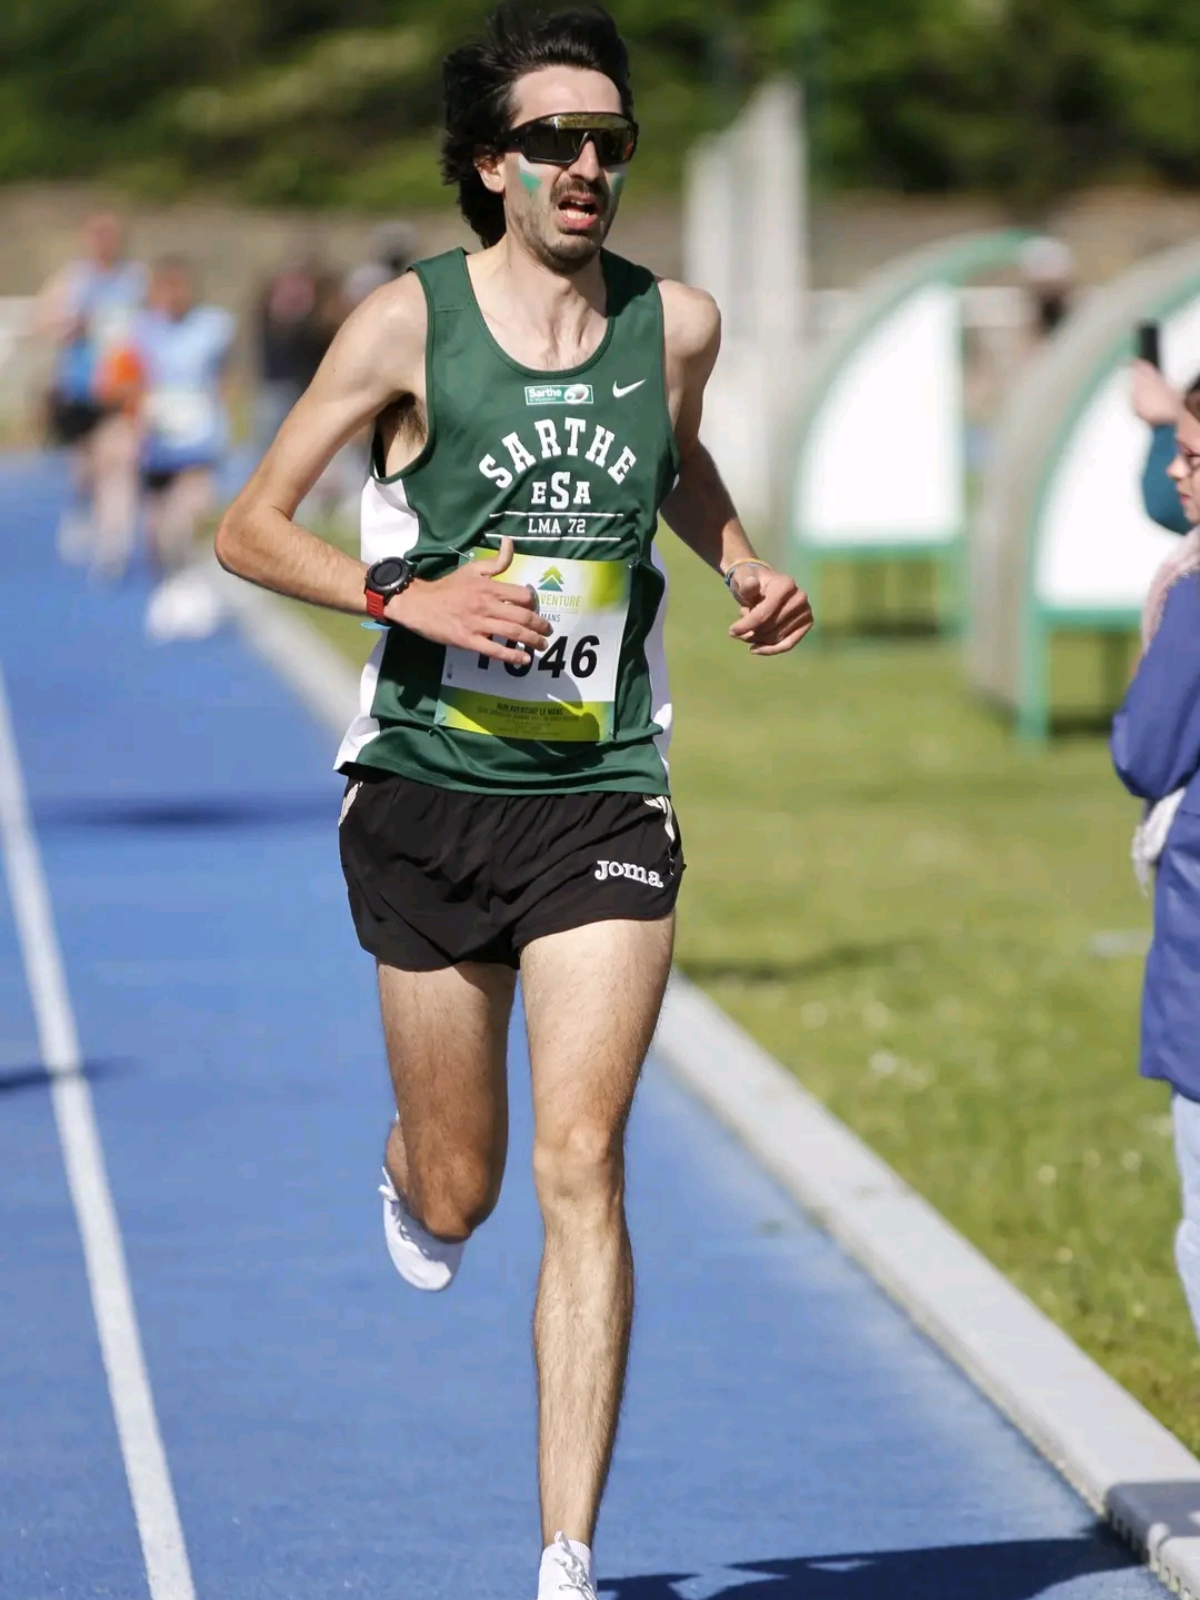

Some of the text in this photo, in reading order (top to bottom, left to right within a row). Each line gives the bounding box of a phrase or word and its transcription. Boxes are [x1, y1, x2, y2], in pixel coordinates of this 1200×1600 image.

[528, 386, 562, 398] Sarthe
[478, 417, 637, 489] SARTHE
[528, 518, 586, 534] LMA 72
[539, 593, 582, 607] VENTURE
[594, 860, 664, 888] Joma
